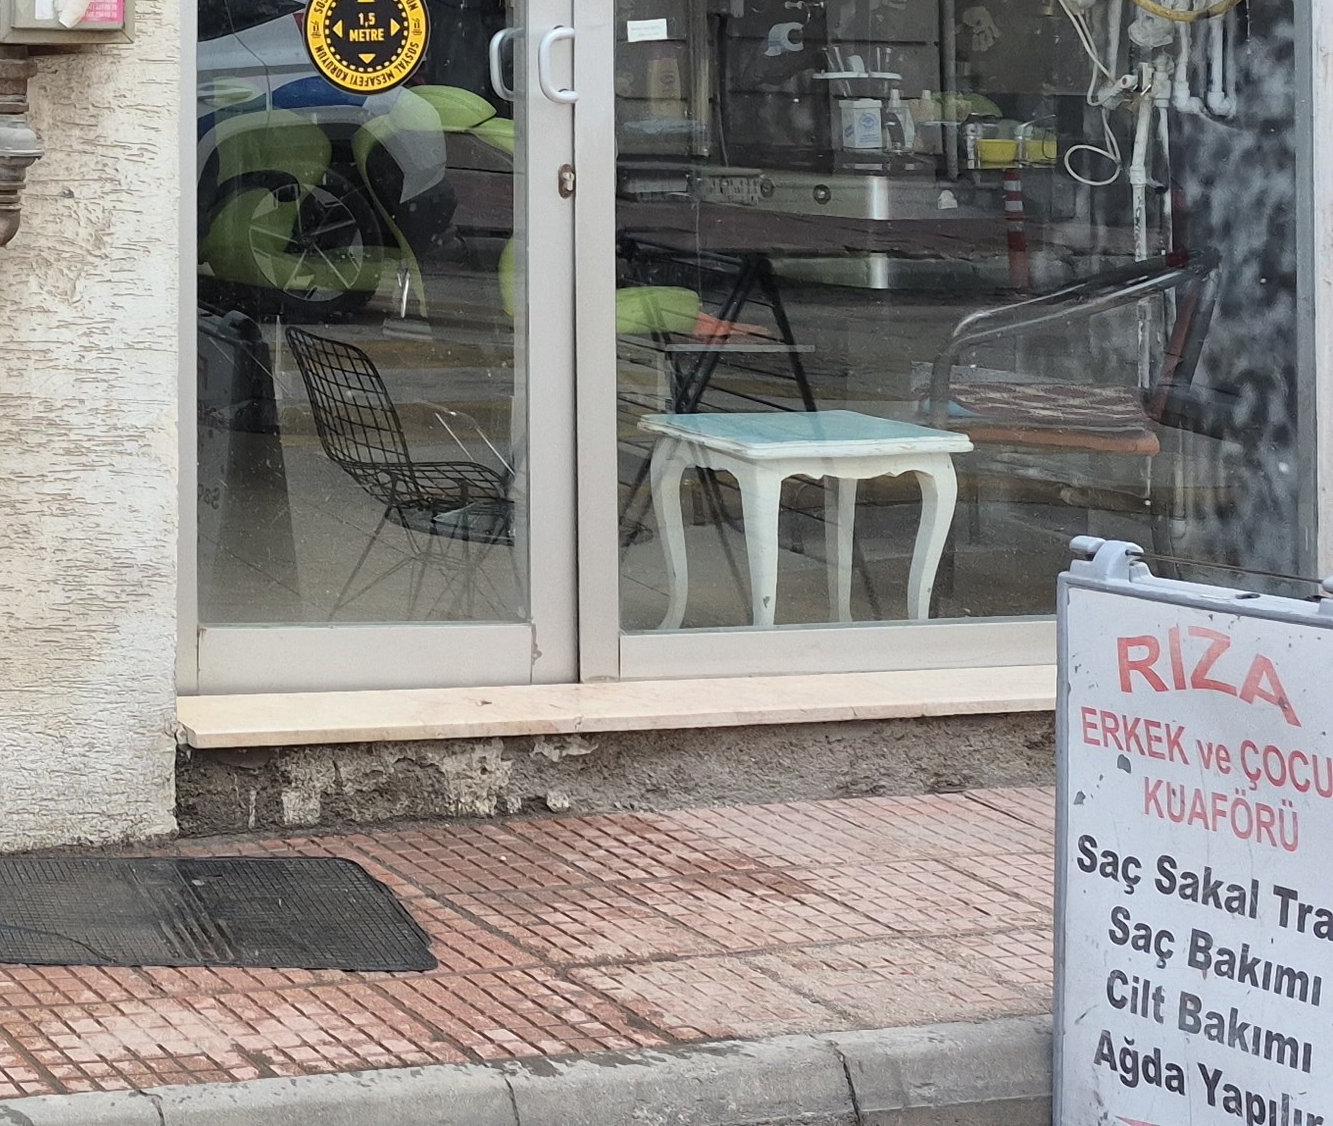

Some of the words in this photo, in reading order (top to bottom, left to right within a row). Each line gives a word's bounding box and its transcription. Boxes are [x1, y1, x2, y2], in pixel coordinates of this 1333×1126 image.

[349, 28, 385, 42] METRE
[358, 12, 376, 27] 1,5
[315, 45, 349, 82] KORUYUN
[393, 42, 419, 73] SOSYAL
[1116, 625, 1302, 727] RIZA
[1080, 705, 1190, 766] ERKEK
[1196, 739, 1232, 775] ve
[1144, 776, 1299, 852] KUAFÖRÜ
[1076, 834, 1142, 895] Saç
[1154, 854, 1259, 920] Sakal
[1108, 905, 1175, 969] Saç
[1187, 927, 1323, 1007] Bakımı
[1106, 969, 1165, 1024] Cilt
[1178, 990, 1313, 1074] Bakımı
[1093, 1029, 1186, 1096] Ağda
